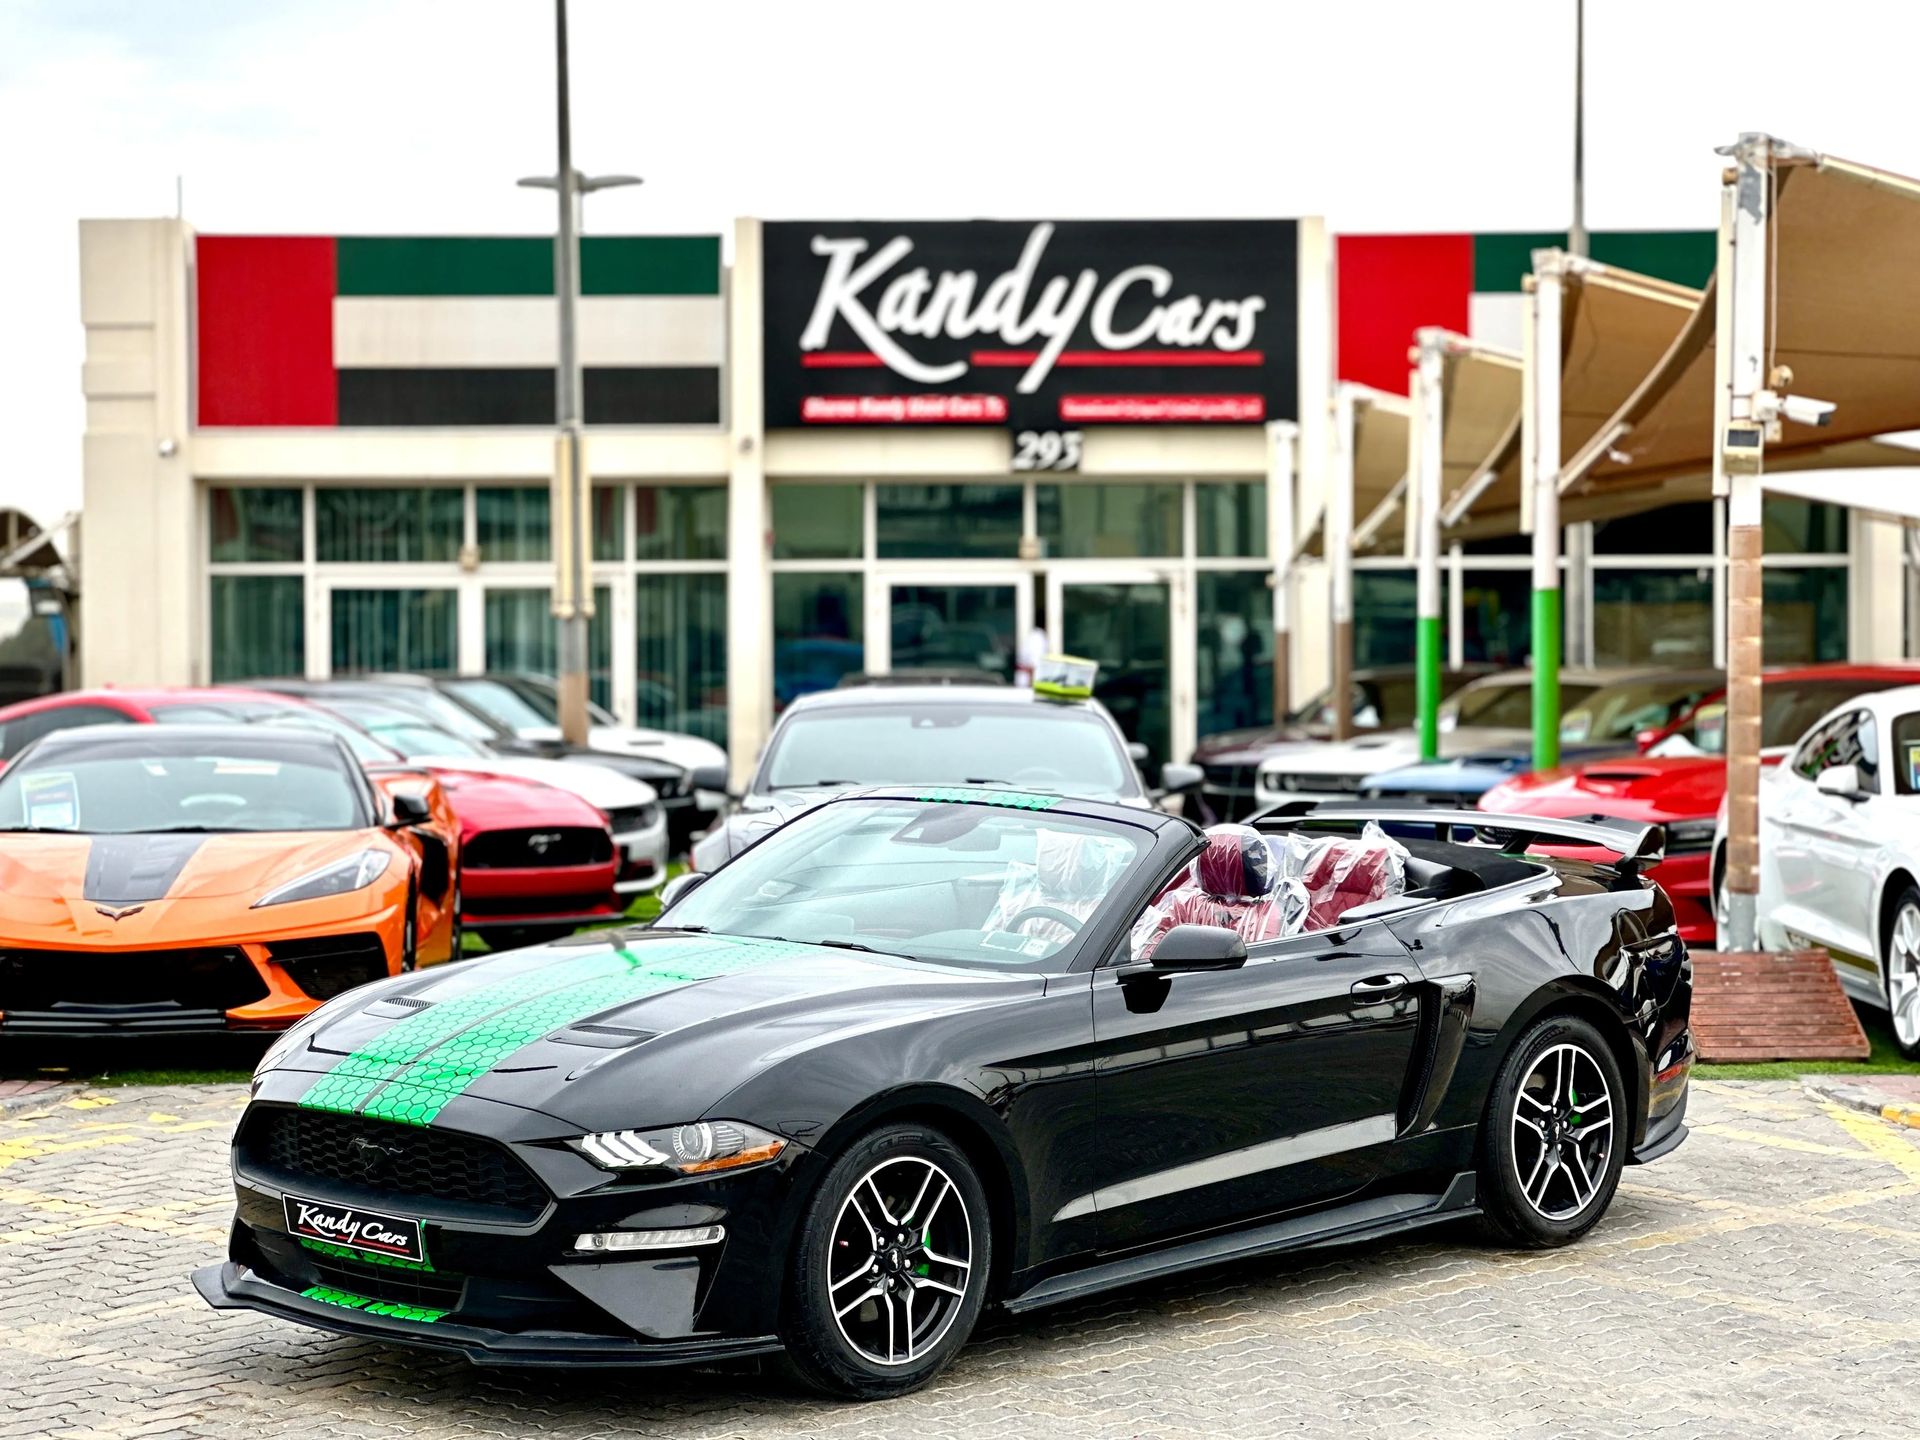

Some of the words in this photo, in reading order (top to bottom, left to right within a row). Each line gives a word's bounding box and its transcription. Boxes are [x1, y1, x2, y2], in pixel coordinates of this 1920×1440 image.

[800, 222, 1098, 393] Kandy
[1091, 265, 1266, 350] Cars
[297, 1203, 360, 1243] Kandy
[361, 1222, 408, 1246] Cars
